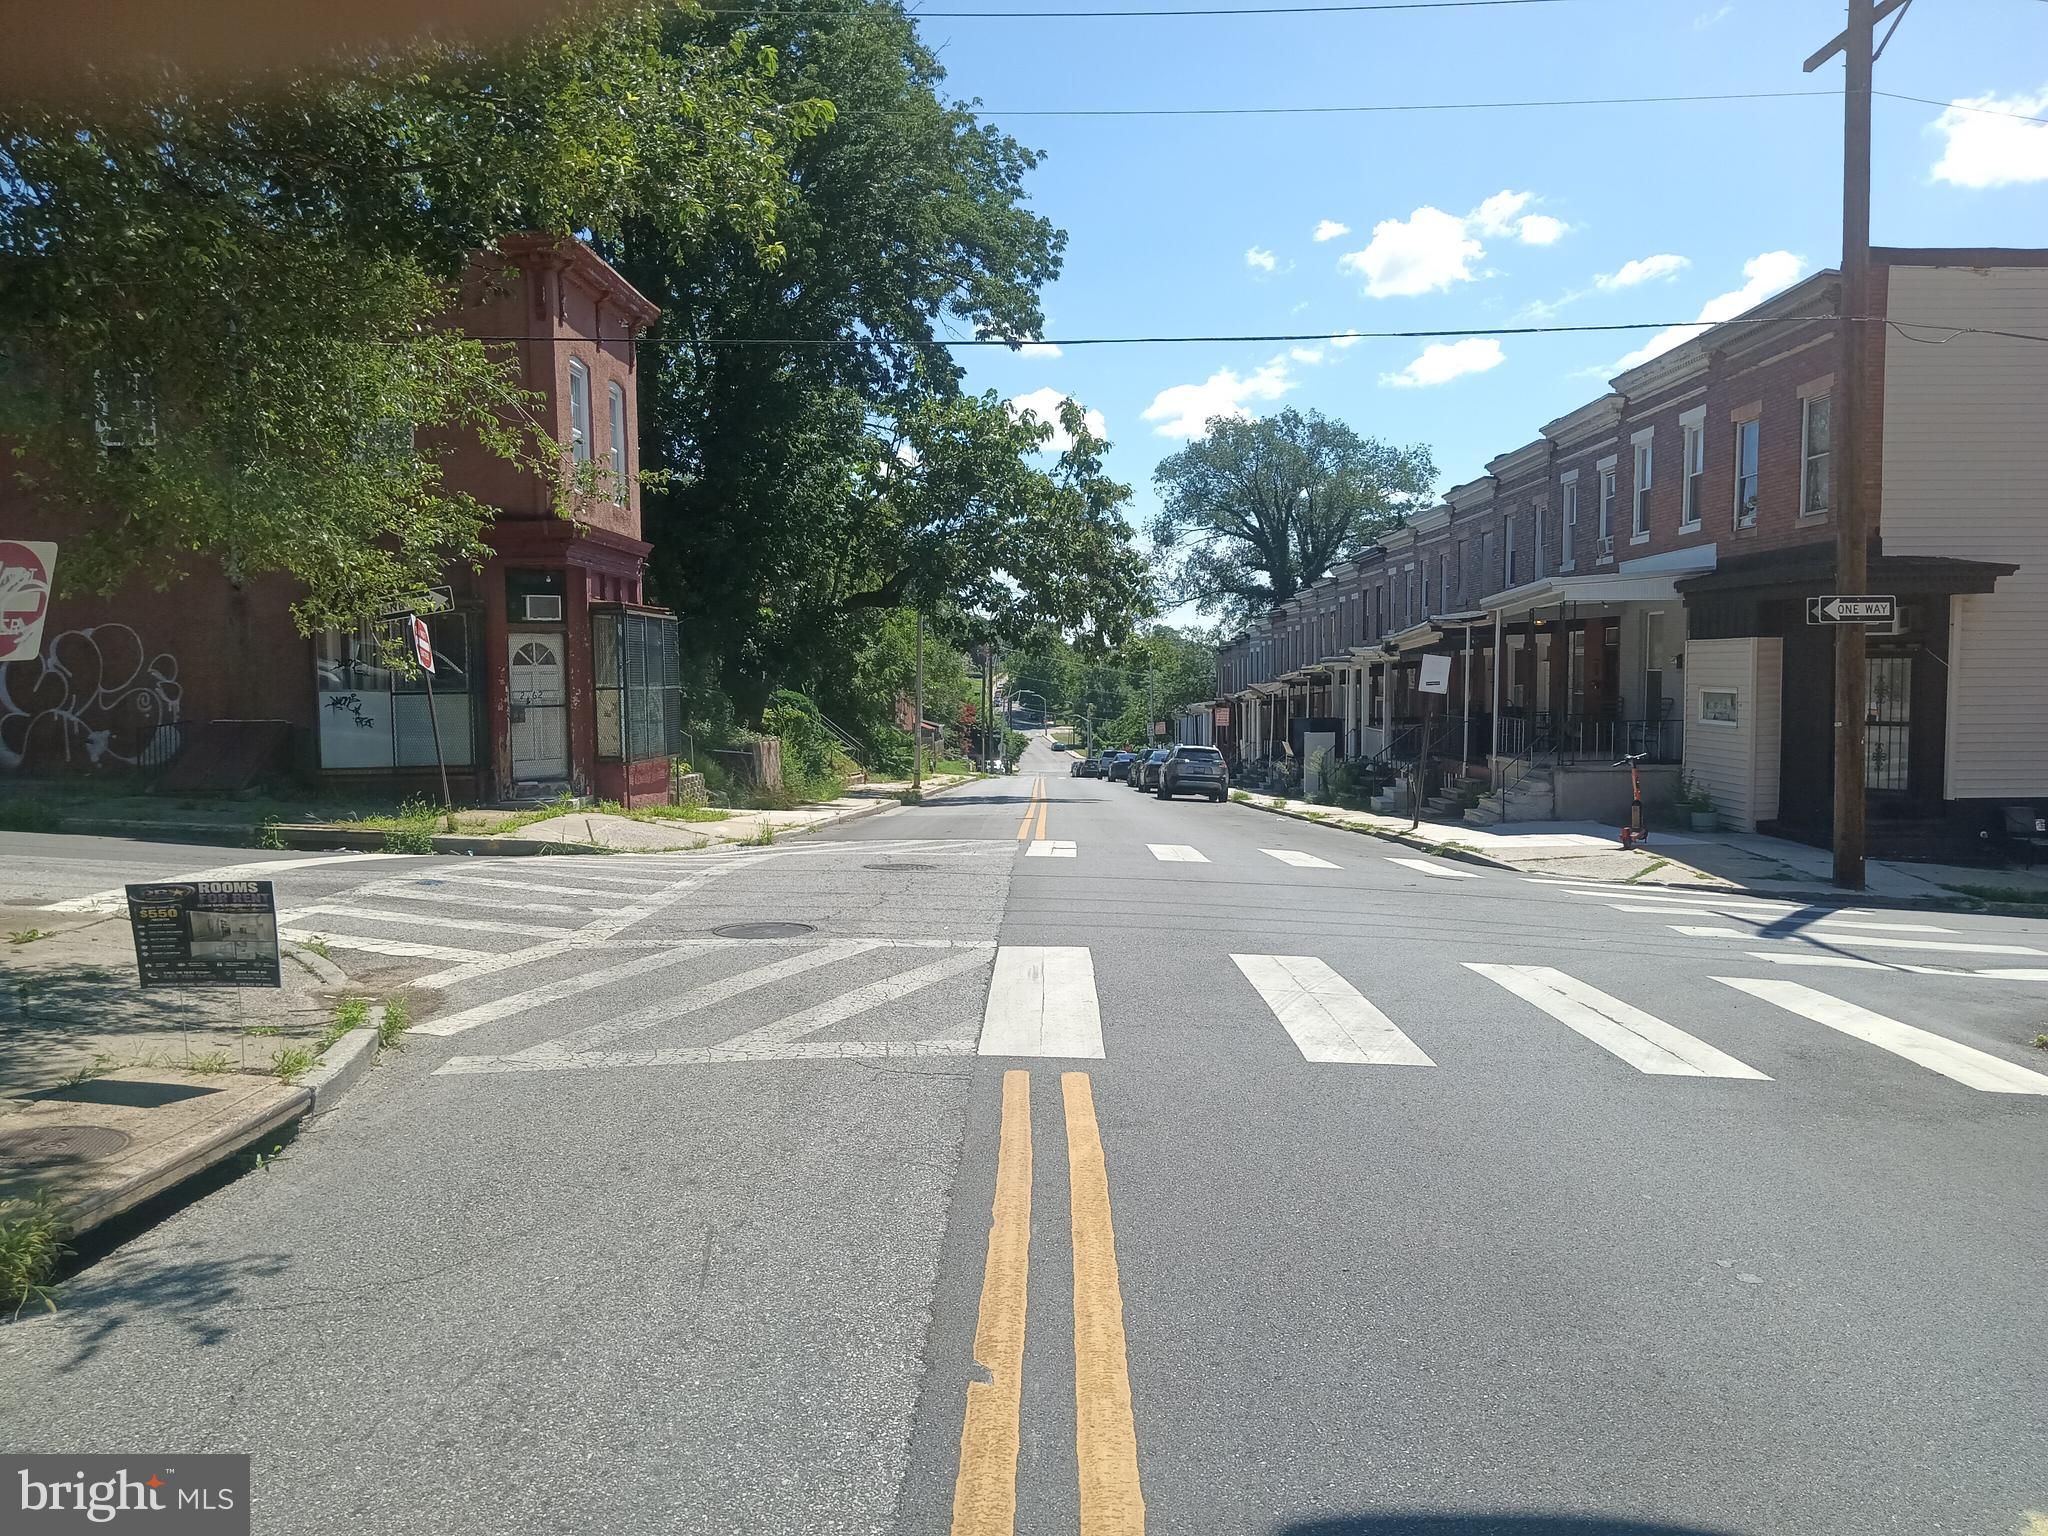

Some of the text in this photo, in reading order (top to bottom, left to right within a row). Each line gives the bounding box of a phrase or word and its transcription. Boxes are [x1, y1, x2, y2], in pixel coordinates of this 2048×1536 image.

[1837, 604, 1888, 615] ONE WAY
[198, 882, 258, 893] ROOMS
[199, 893, 270, 903] FOR RENT
[139, 908, 178, 919] $550
